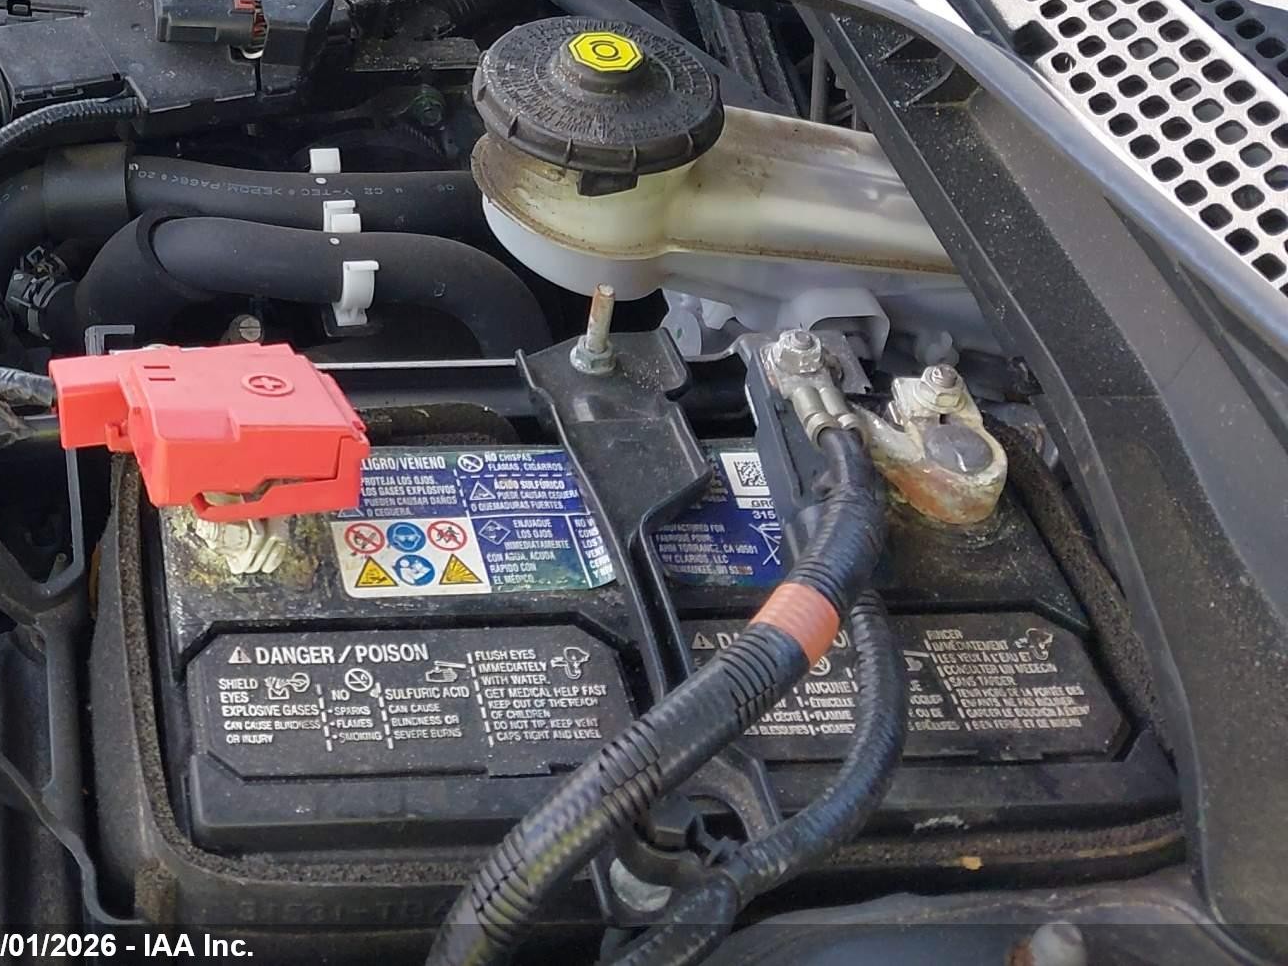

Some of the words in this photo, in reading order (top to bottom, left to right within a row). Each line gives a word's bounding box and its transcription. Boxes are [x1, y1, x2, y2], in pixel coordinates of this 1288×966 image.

[485, 452, 497, 462] NO
[360, 456, 446, 471] LIGRO/VENENO
[398, 476, 413, 485] LOS
[362, 487, 378, 496] LOS
[379, 486, 405, 496] GASES
[406, 485, 456, 495] EXPLOSIVOS
[517, 530, 532, 538] LOS
[255, 646, 334, 664] DANGER
[356, 643, 429, 663] POISON
[475, 651, 508, 661] FLUSH
[510, 649, 536, 660] EYES
[479, 662, 547, 673] IMMEDIATELY
[219, 678, 258, 690] SHIELD
[481, 675, 508, 686] WITH
[510, 675, 551, 685] WATER.
[385, 686, 440, 700] SULFURIC
[443, 686, 470, 698] ACID
[485, 688, 505, 699] GET
[509, 687, 551, 698] MEDICAL
[555, 686, 579, 697] HELP
[805, 681, 852, 694] AUCUNE
[220, 692, 249, 703] EYES
[332, 690, 349, 701] NO
[389, 704, 408, 714] CAN
[411, 703, 441, 713] CAUSE
[489, 700, 511, 709] KEEP
[513, 699, 532, 709] OUT
[549, 698, 568, 708] THE
[568, 698, 599, 707] REACH
[222, 706, 281, 717] EXPLOSIVE
[283, 705, 319, 716] GASES
[491, 710, 504, 719] OF
[506, 709, 551, 719] CHILDREN
[224, 721, 242, 730] CAN
[244, 721, 272, 730] CAUSE
[274, 720, 321, 729] BLINDNESS
[392, 715, 442, 727] BLINDNESS
[444, 715, 460, 724] OR
[494, 721, 509, 730] DO
[510, 720, 529, 730] NOT
[551, 719, 572, 728] KEEP
[574, 718, 599, 727] VENT
[227, 735, 240, 744] OR
[242, 734, 273, 744] INJURY
[394, 729, 429, 740] SEVERE
[496, 732, 521, 741] CAPS
[524, 731, 550, 741] TIGHT
[553, 730, 572, 740] AND
[575, 729, 602, 739] LEVEL
